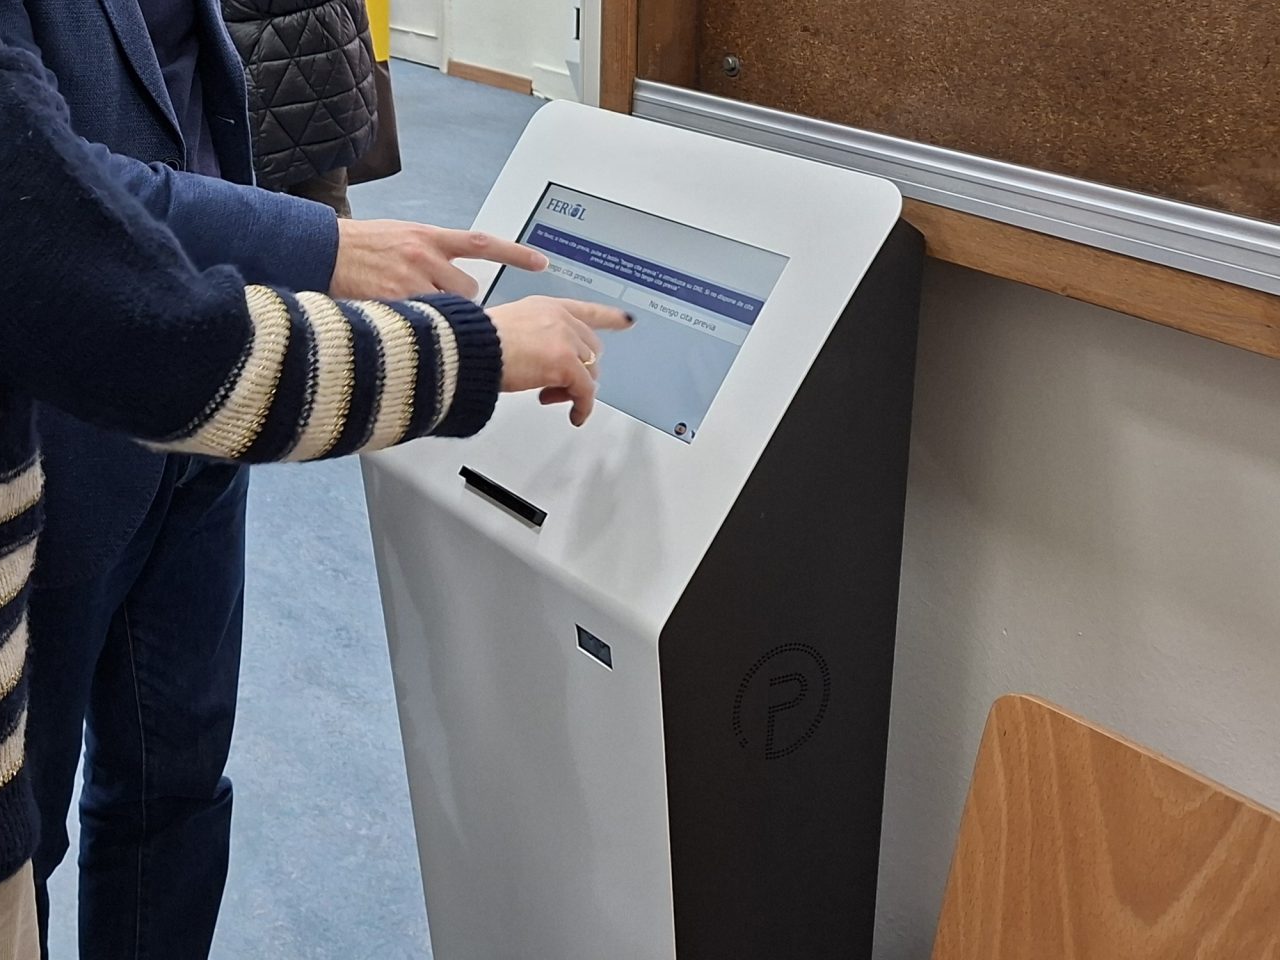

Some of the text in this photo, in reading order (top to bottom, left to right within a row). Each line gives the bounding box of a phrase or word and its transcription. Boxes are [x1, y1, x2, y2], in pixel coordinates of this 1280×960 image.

[649, 299, 716, 332] No tengo cita previa
